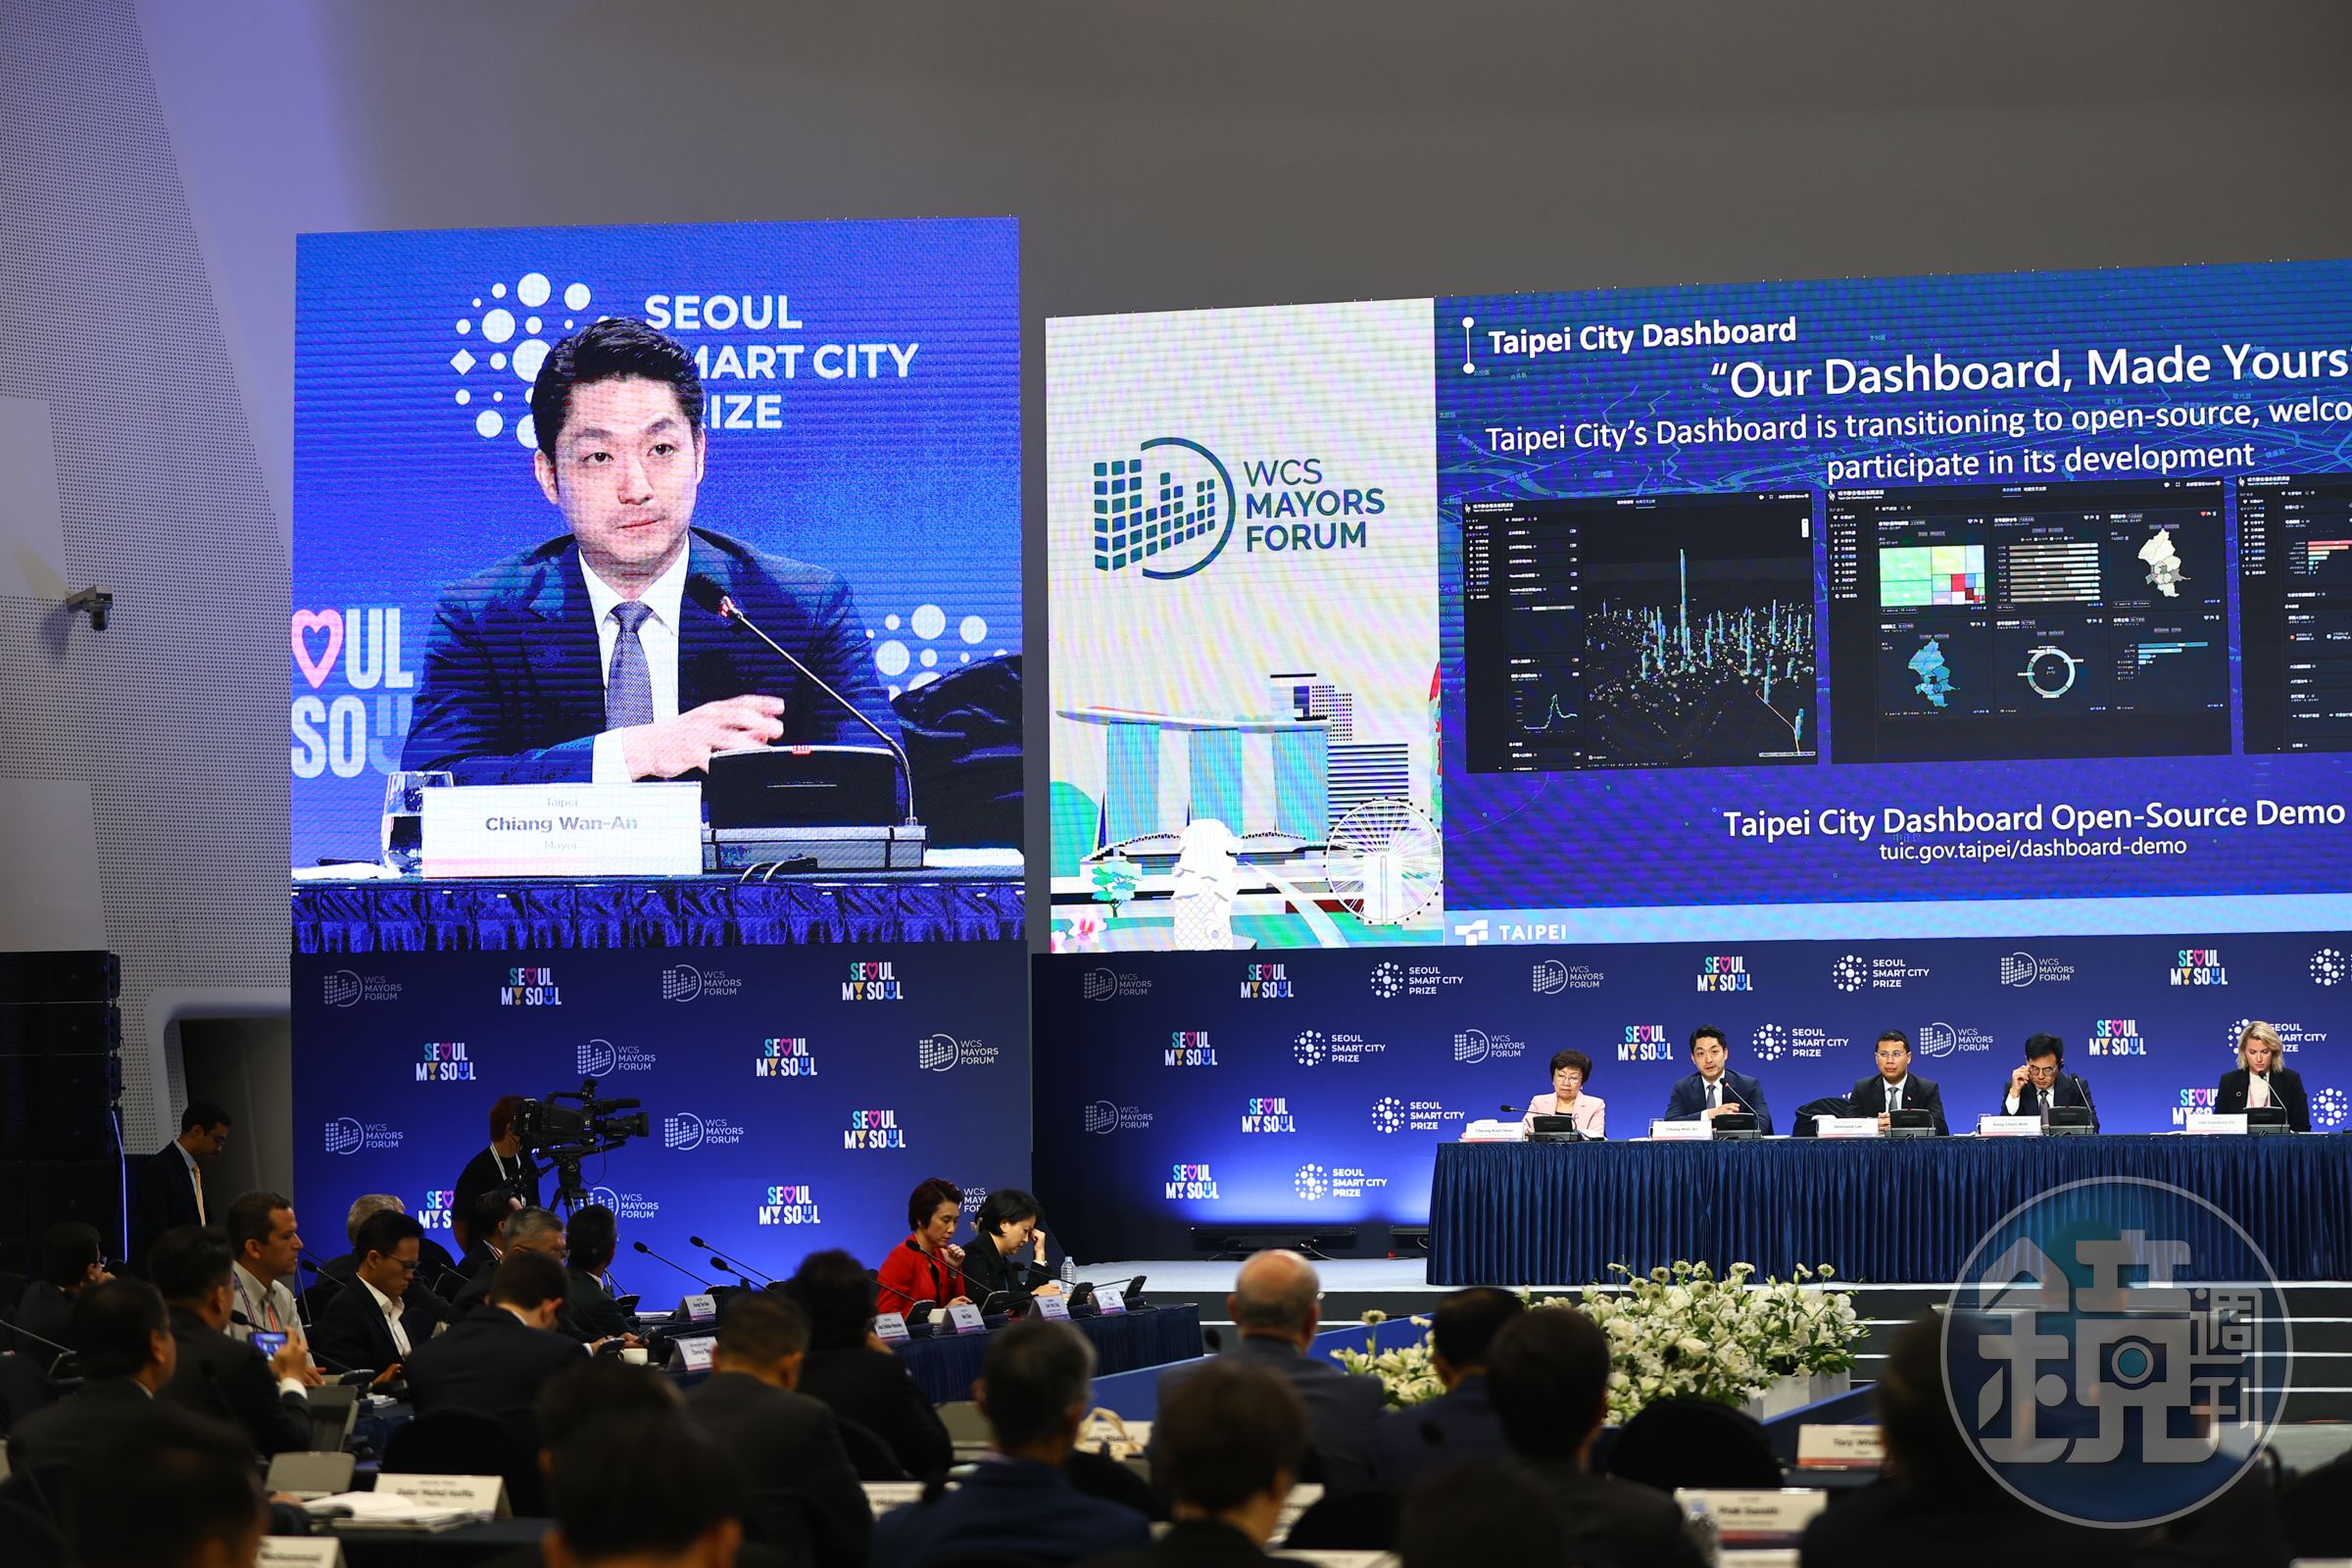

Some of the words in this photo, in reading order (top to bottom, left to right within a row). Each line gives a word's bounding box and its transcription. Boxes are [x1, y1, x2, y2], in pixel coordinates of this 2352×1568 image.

[644, 294, 804, 331] SEOUL
[1488, 326, 1572, 359] Taipei
[1580, 324, 1634, 355] City
[1642, 315, 1797, 349] Dashboard
[812, 342, 919, 379] CITY
[1825, 349, 2073, 395] Dashboard,
[2086, 344, 2211, 387] Made
[2220, 342, 2352, 380] Yours
[701, 393, 784, 430] IZE
[1485, 423, 1565, 456] Taipei
[1574, 418, 1648, 453] City’s
[1656, 413, 1808, 446] Dashboard
[1816, 406, 1838, 441] is
[1844, 407, 2026, 439] transitioning
[2034, 403, 2063, 431] to
[2071, 400, 2260, 436] open-source,
[2269, 395, 2352, 423] welco
[1826, 448, 1980, 486] participate
[1988, 447, 2014, 474] in
[2022, 441, 2056, 475] its
[2064, 440, 2255, 477] development
[1244, 458, 1323, 486] WCS
[1245, 487, 1386, 520] MAYORS
[1246, 520, 1367, 553] FORUM
[485, 816, 553, 833] Chiang
[559, 816, 638, 831] Wan-An
[1722, 808, 1812, 844] Taipei
[1818, 807, 1876, 841] City
[1882, 803, 2044, 835] Dashboard
[2049, 800, 2248, 837] Open-Source
[2255, 799, 2346, 825] Demo
[1879, 835, 2188, 863] tuic.gov.taipei/dashboard-demo
[1499, 924, 1567, 941] TAIPEI
[1907, 968, 1930, 977] CITY
[2038, 965, 2075, 974] MAYORS
[1408, 976, 1442, 985] SMART
[1442, 976, 1464, 985] CITY
[1570, 972, 1604, 981] MAYORS
[1408, 986, 1437, 996] PRIZE
[1331, 1034, 1363, 1043] SEOUL
[2304, 1033, 2327, 1042] CITY
[1791, 1038, 1826, 1047] SMART
[1827, 1038, 1849, 1047] CITY
[960, 1048, 999, 1056] MAYORS
[1331, 1044, 1363, 1053] SMART
[1364, 1044, 1386, 1053] CITY
[1792, 1049, 1822, 1057] PRIZE
[1331, 1054, 1359, 1063] PRIZE
[1410, 1111, 1443, 1120] SMART
[1443, 1111, 1465, 1120] CITY
[1410, 1121, 1439, 1130] PRIZE
[1333, 1168, 1364, 1177] SEOUL
[1333, 1189, 1361, 1198] PRIZE
